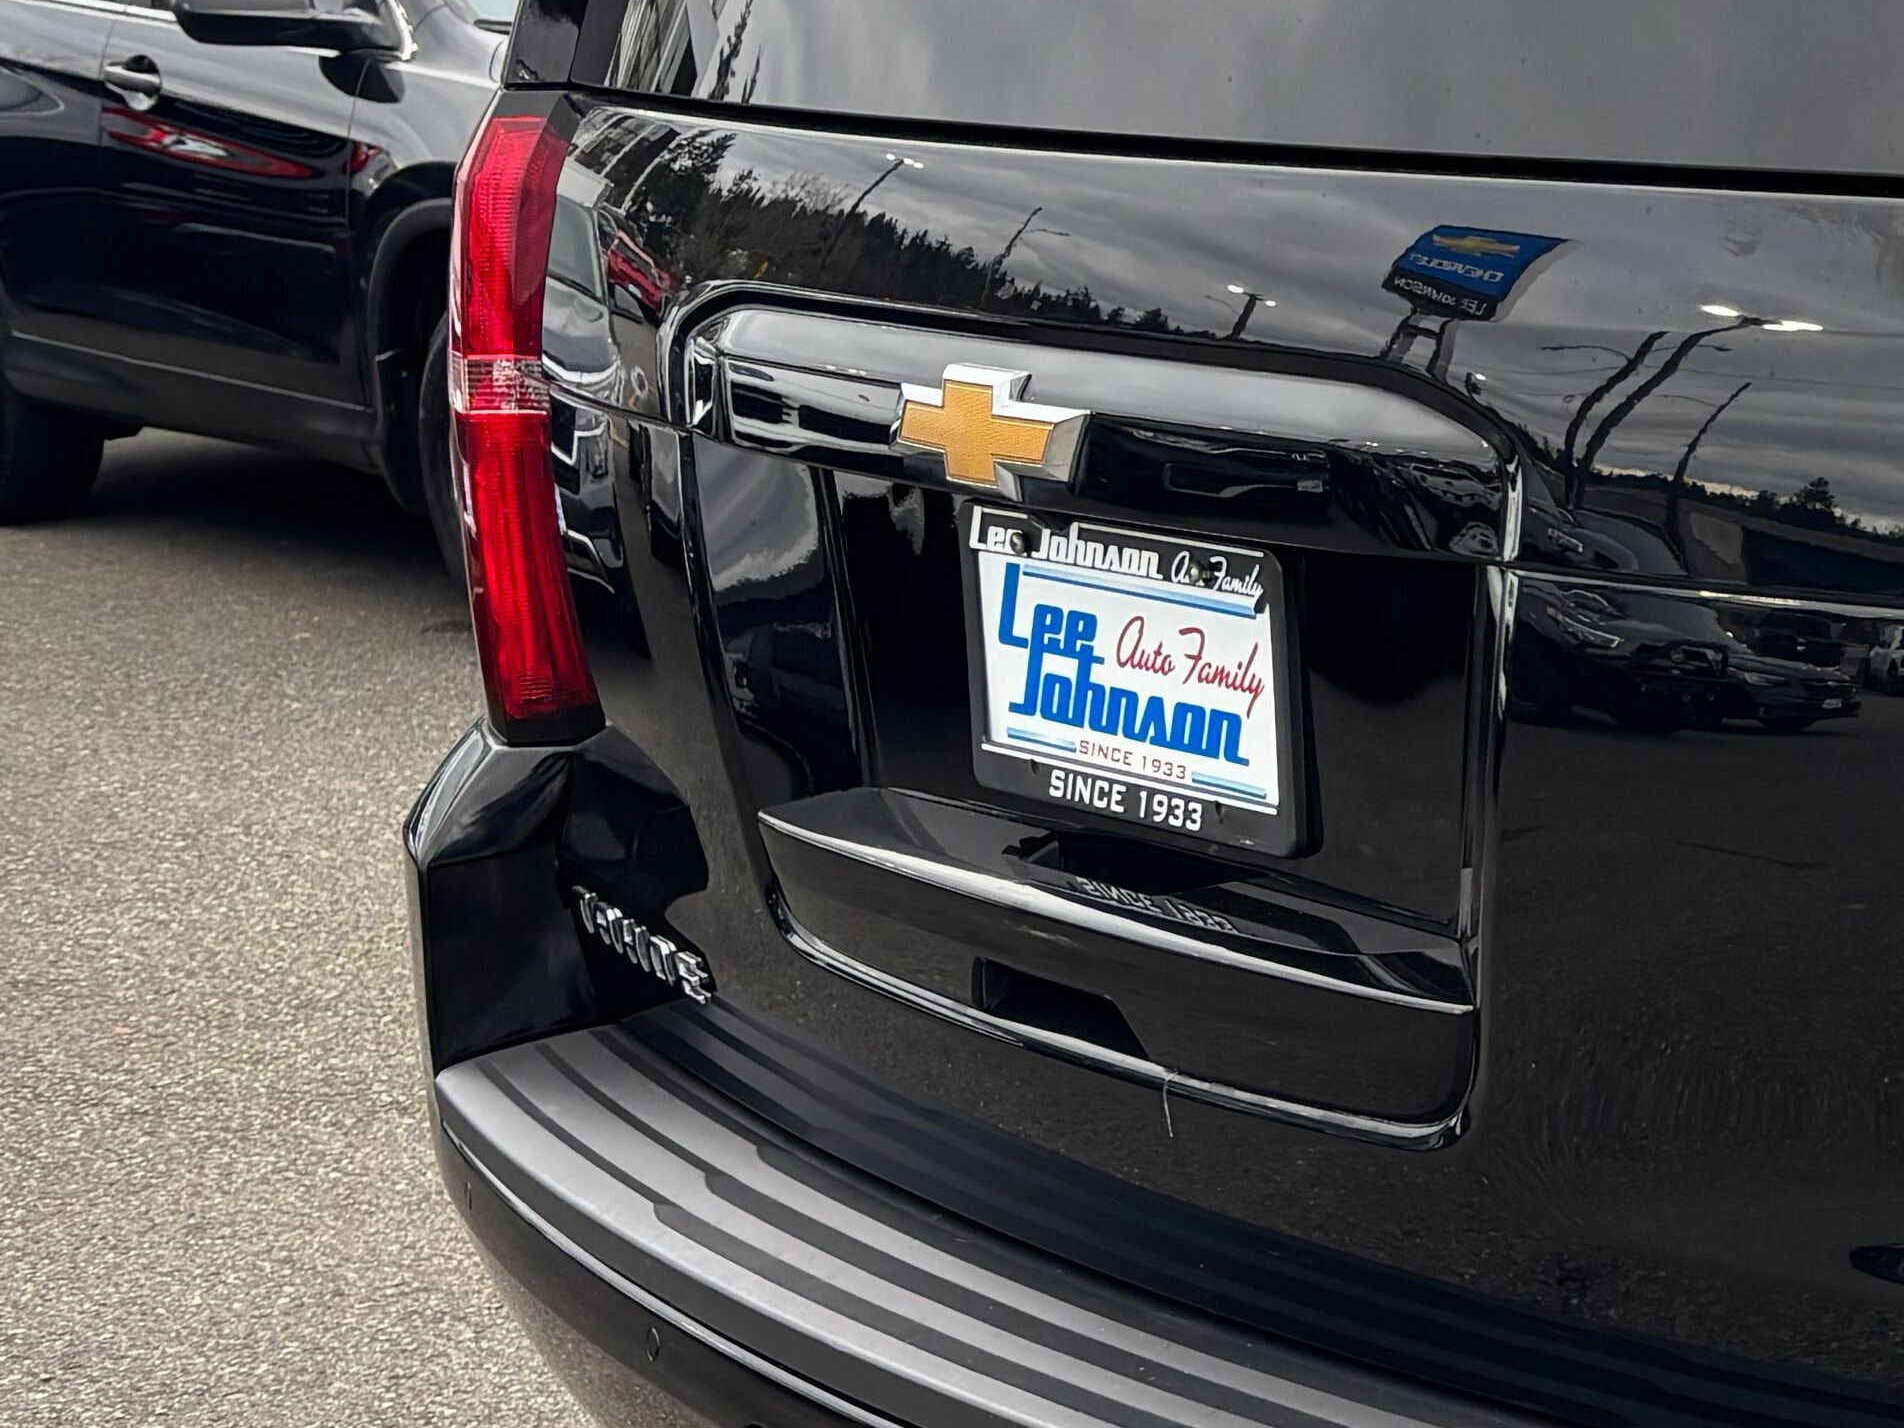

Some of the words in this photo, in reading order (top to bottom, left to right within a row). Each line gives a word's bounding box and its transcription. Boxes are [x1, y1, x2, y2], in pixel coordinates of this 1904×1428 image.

[998, 563, 1101, 657] Lee
[1031, 522, 1163, 580] Johnson
[1209, 555, 1264, 615] Family
[1008, 650, 1250, 767] Johnson
[1116, 615, 1176, 677] Auto
[1178, 627, 1265, 719] Family
[1049, 770, 1126, 813] SINCE
[1138, 789, 1203, 832] 1933
[1078, 739, 1133, 767] SINCE
[1140, 755, 1188, 780] 1933
[572, 885, 712, 1005] TAHOE
